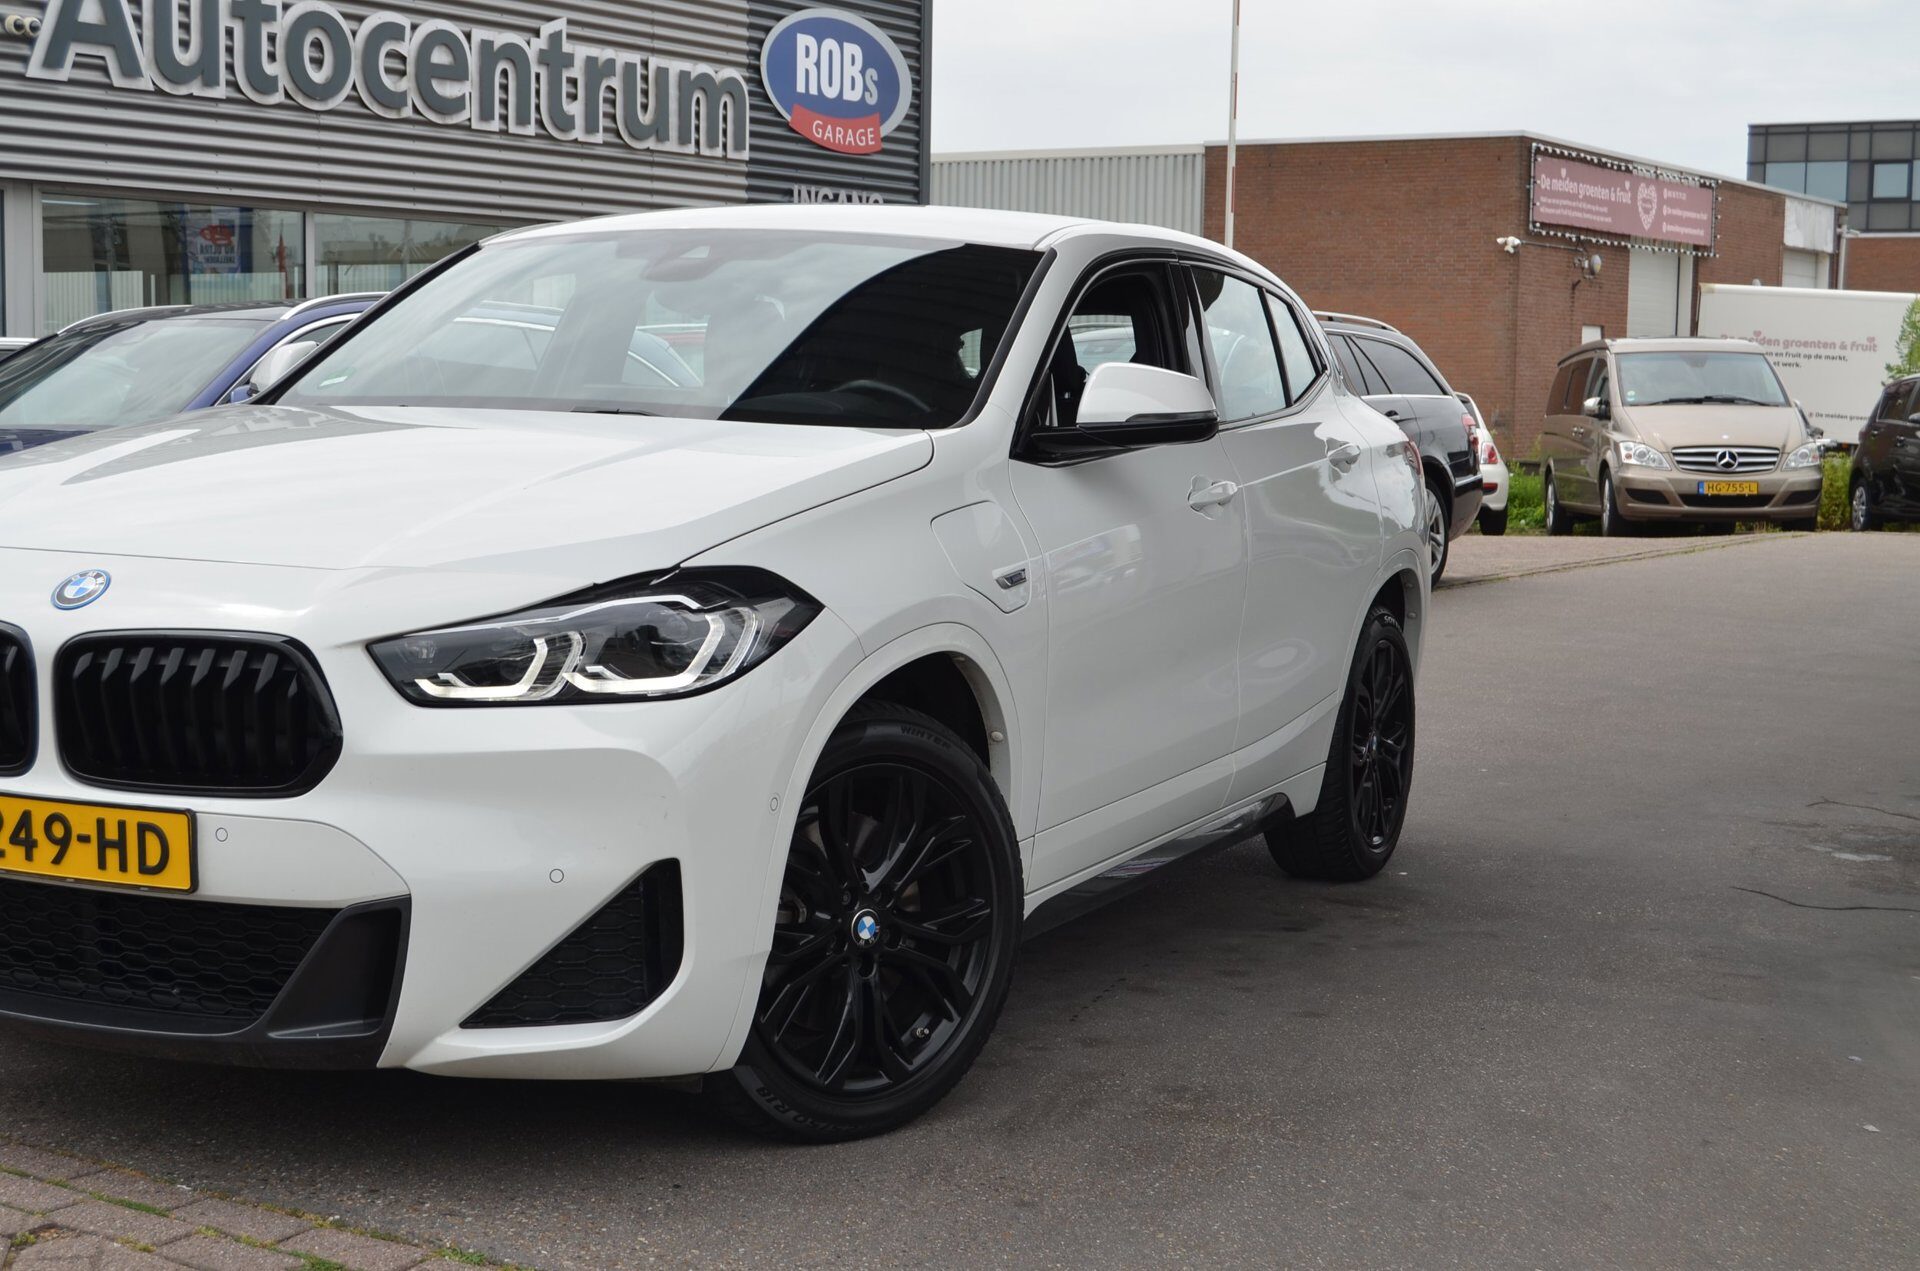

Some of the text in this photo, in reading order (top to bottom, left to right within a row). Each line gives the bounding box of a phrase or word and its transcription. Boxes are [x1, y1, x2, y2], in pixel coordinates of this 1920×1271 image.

[26, 0, 748, 160] Autocentrum
[796, 33, 879, 106] ROBs
[811, 119, 876, 147] GARAGE
[1540, 174, 1550, 190] De
[1551, 169, 1578, 194] meiden
[1579, 183, 1609, 202] groenten
[1616, 181, 1632, 204] fruit
[1782, 339, 1837, 350] groenten
[1840, 341, 1848, 351] &
[1850, 337, 1877, 352] fruit
[1707, 482, 1754, 493] HG-755-L
[0, 808, 170, 876] 49-HD
